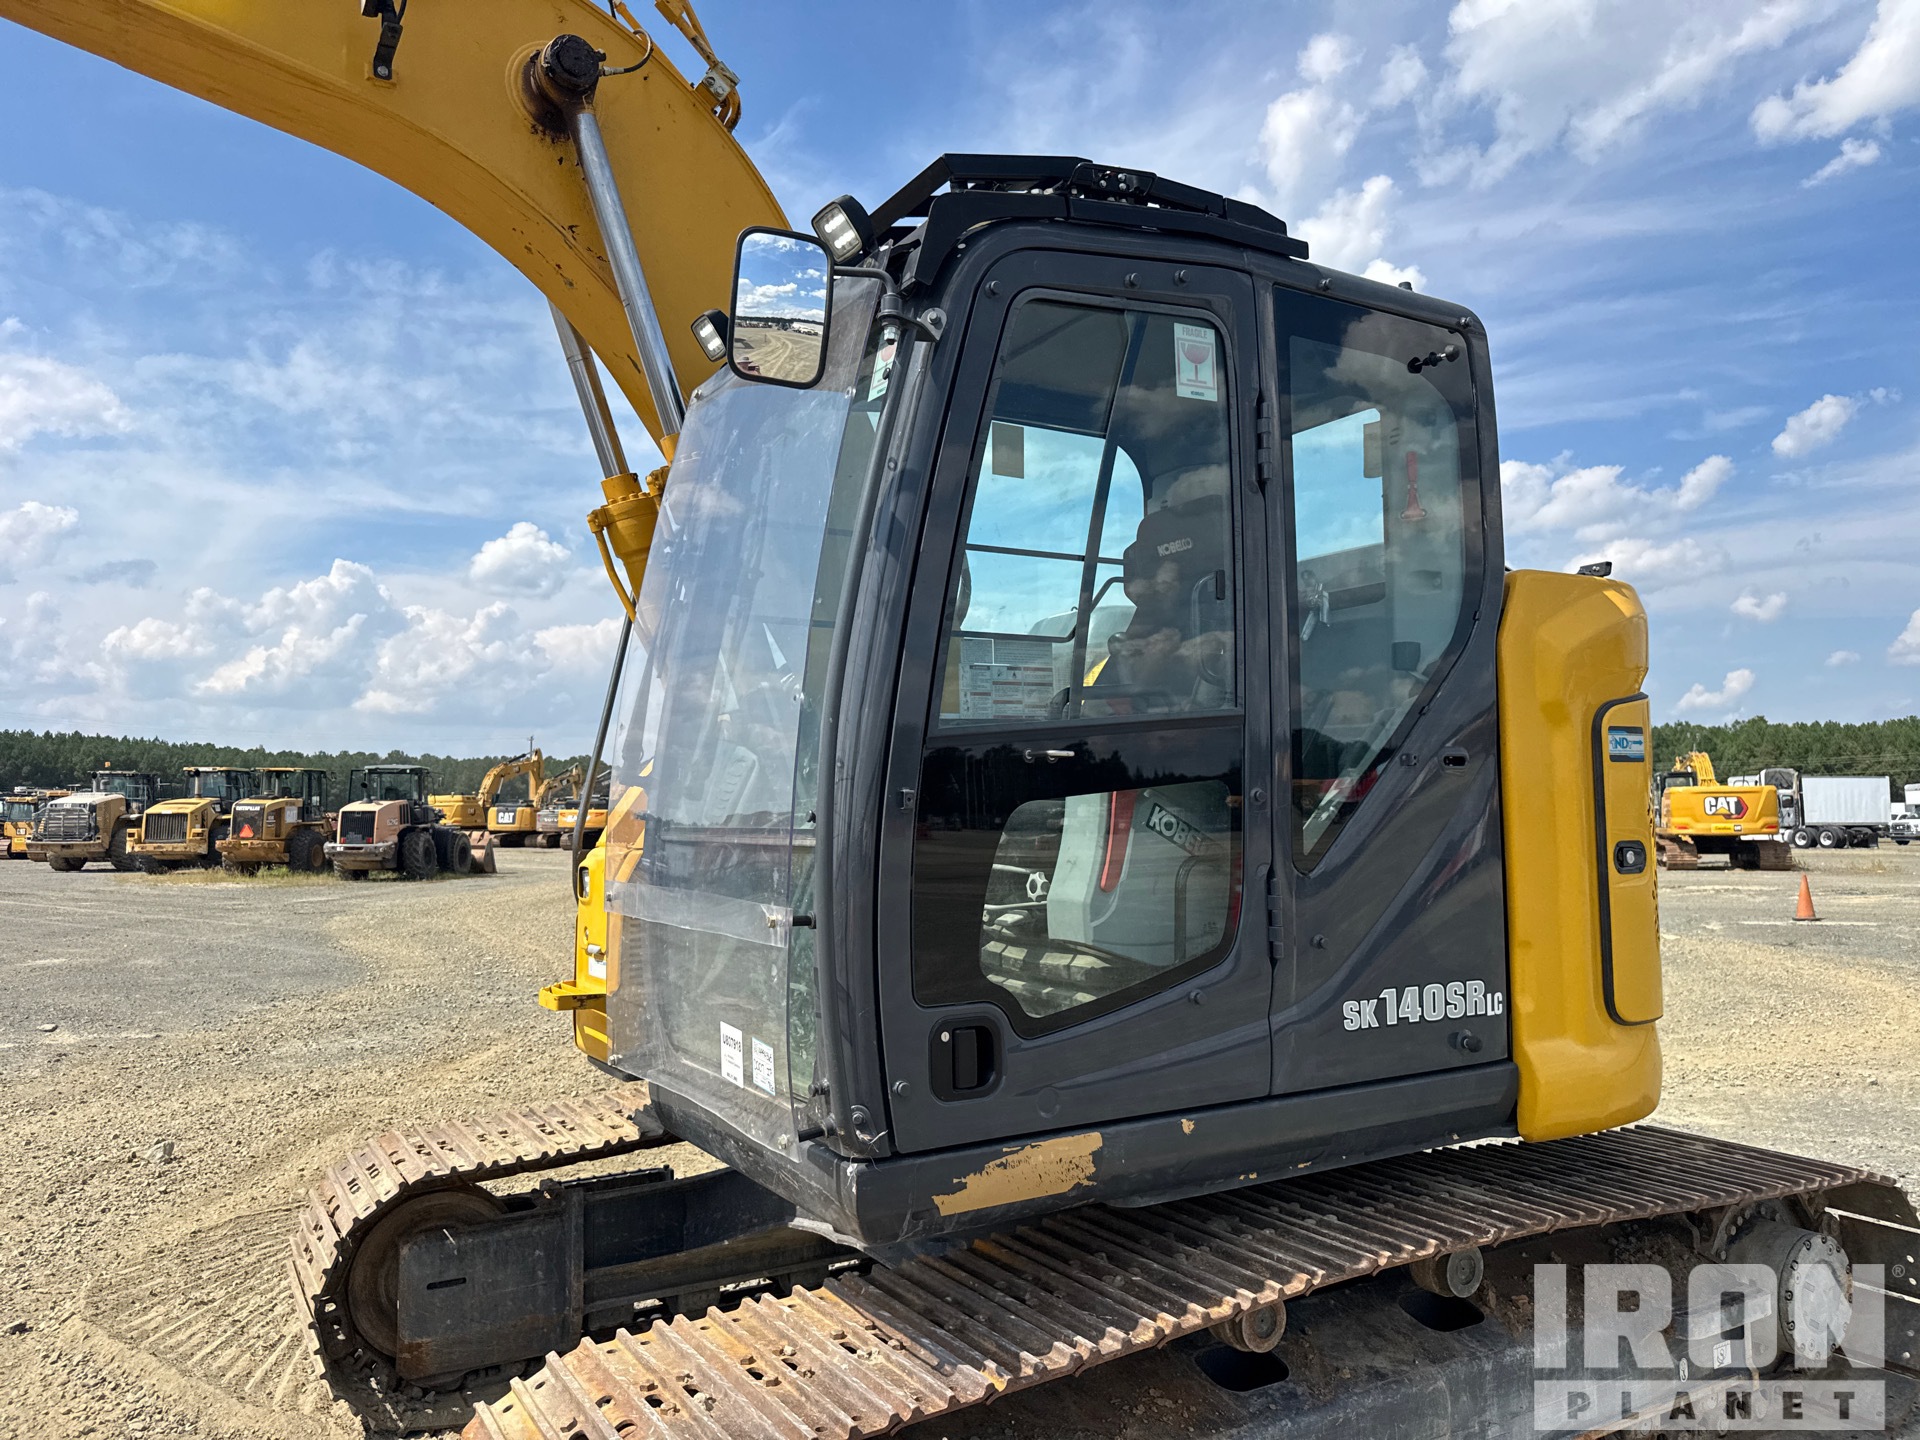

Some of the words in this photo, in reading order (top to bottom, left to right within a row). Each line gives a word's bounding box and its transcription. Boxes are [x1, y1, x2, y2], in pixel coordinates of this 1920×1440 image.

[1182, 326, 1208, 339] FRAGILE
[1156, 538, 1193, 557] KOBELCO
[1704, 796, 1738, 815] CAT
[498, 812, 514, 823] CAT
